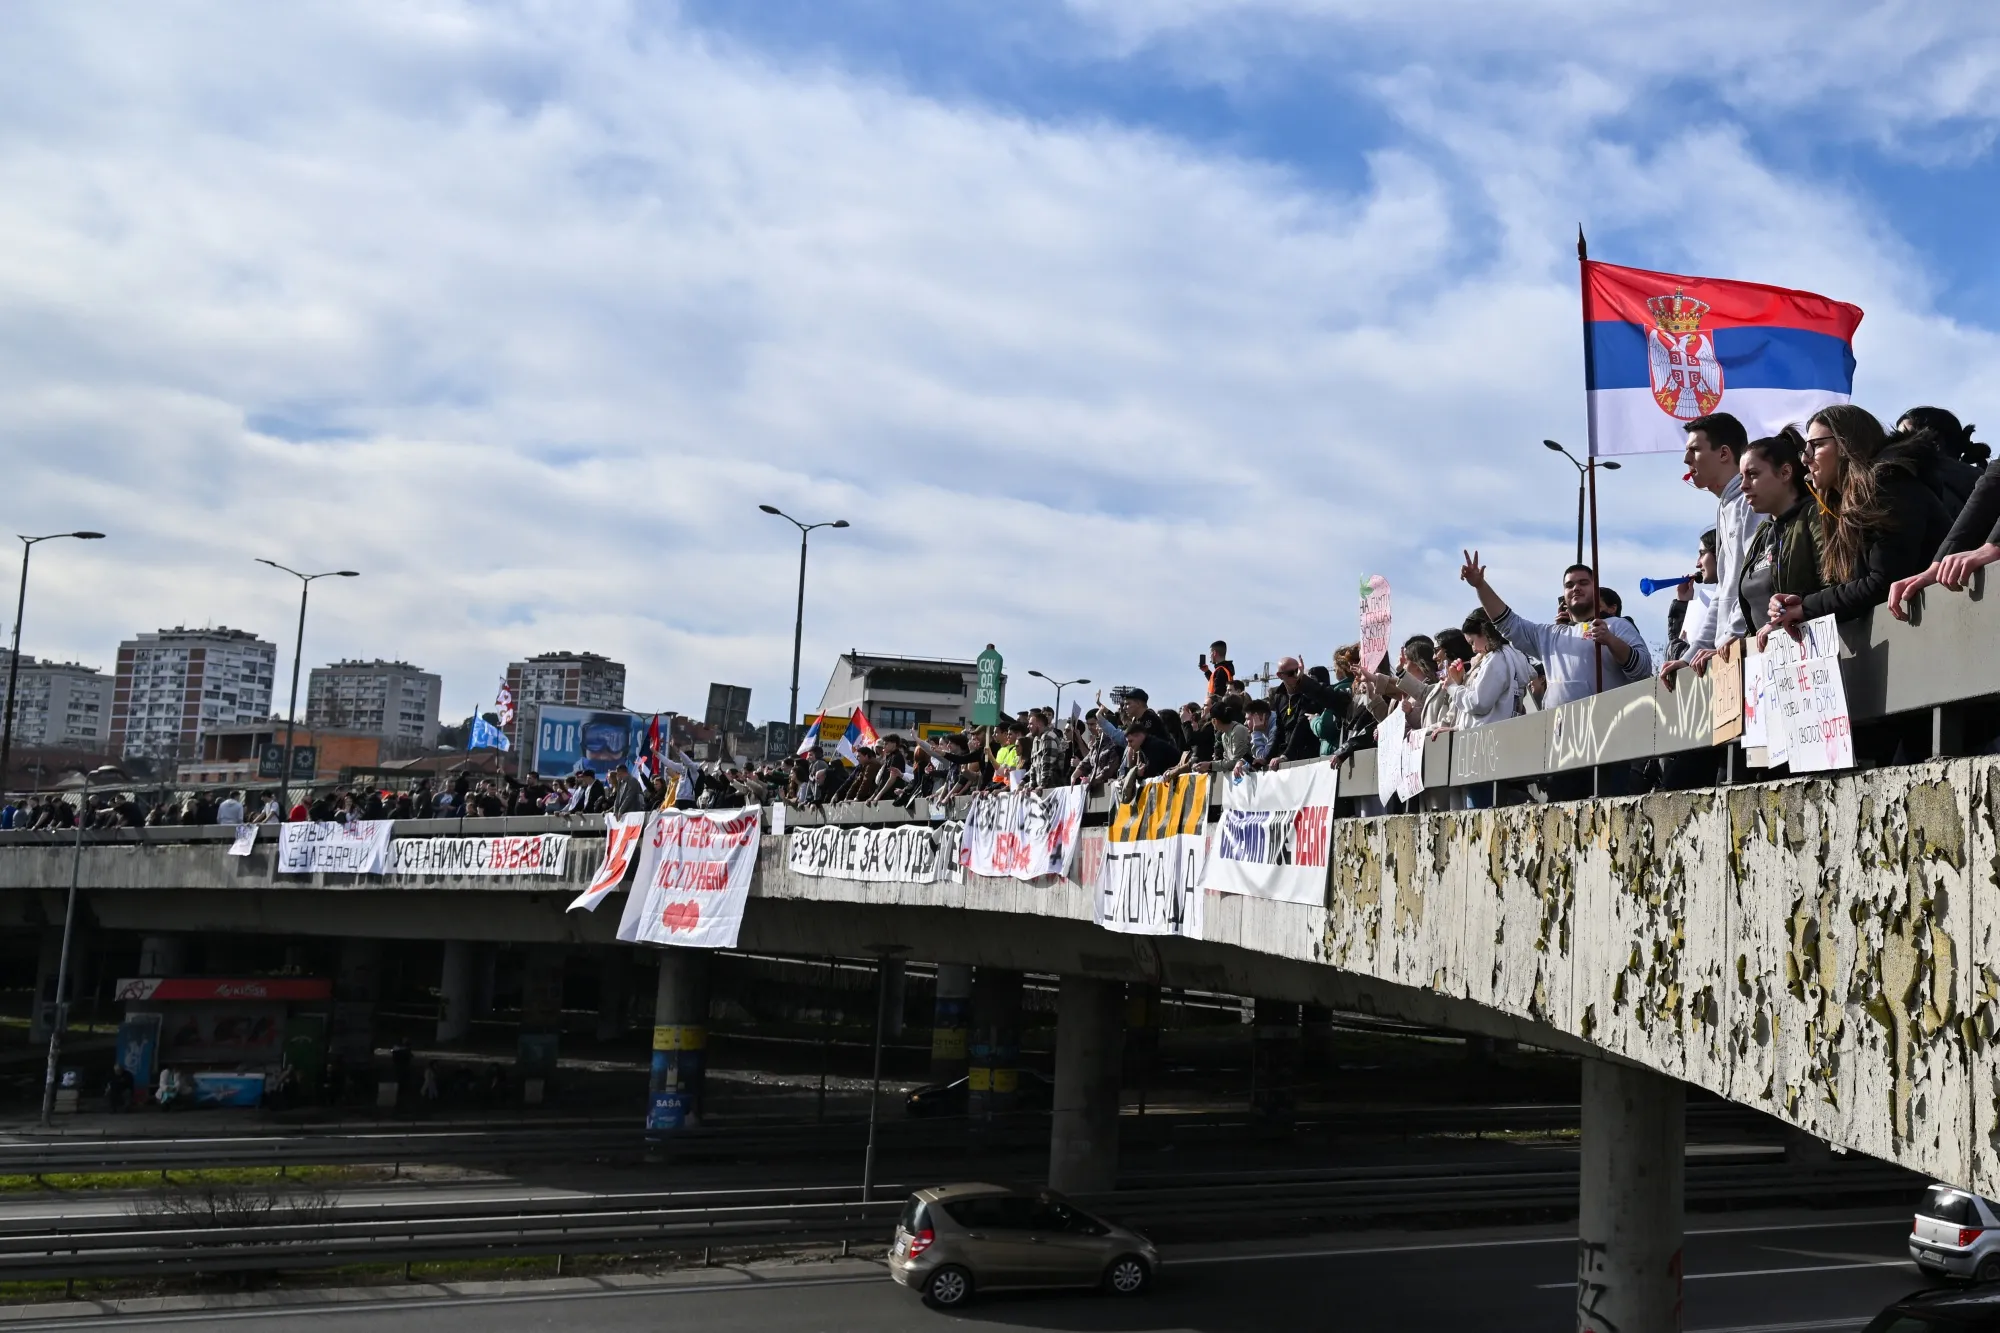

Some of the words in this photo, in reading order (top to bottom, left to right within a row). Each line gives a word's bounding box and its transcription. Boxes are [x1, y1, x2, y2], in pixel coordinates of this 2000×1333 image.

[979, 658, 996, 673] СОК
[980, 674, 993, 688] ОД
[1797, 664, 1811, 692] НЕ
[1811, 669, 1831, 686] ЖЕЛИ
[974, 688, 997, 705] ЈАБУКЕ
[288, 823, 335, 843] БИВШИ
[653, 815, 720, 849] ЗАХТЕВИ
[288, 845, 371, 868] БУЛЕВАРЦИ
[393, 839, 474, 869] УСТАНИМО
[476, 839, 487, 868] С
[488, 836, 562, 869] ЉУБАВЉУ
[860, 830, 881, 873] ЗА
